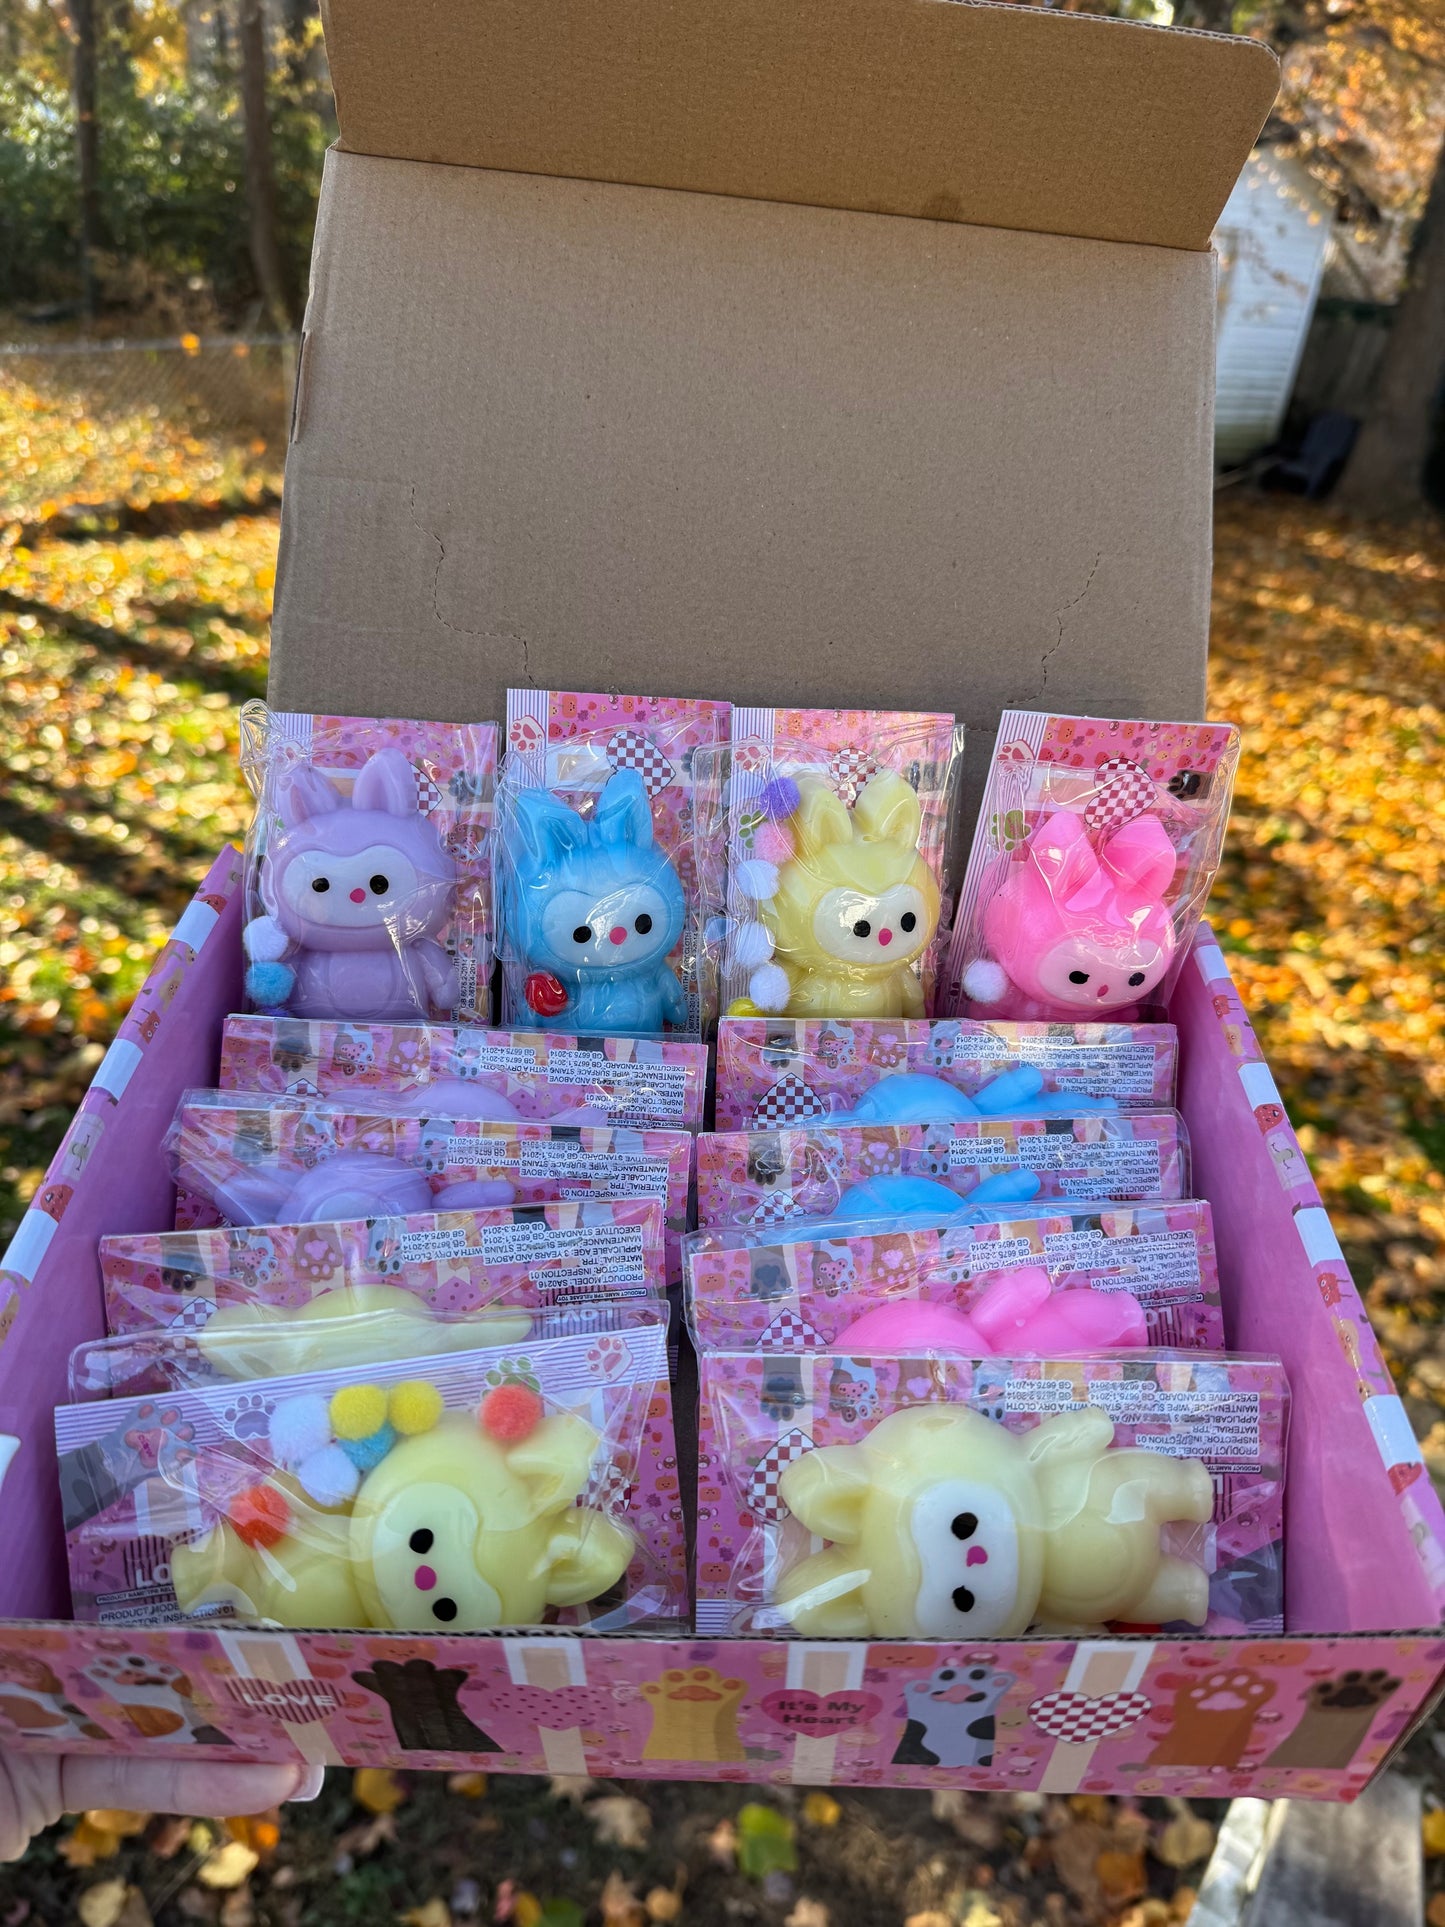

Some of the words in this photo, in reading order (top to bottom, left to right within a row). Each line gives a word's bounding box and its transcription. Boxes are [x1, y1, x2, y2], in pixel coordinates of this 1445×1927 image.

[476, 1156, 491, 1164] DRY
[499, 1157, 520, 1166] WITH
[451, 1229, 464, 1237] GB
[594, 1224, 640, 1236] EXECUTIVE
[401, 1230, 449, 1241] 6675.4-2014
[531, 1232, 544, 1241] GB
[1016, 1237, 1028, 1246] GB
[460, 1247, 483, 1256] WITH
[484, 1244, 514, 1254] STAINS
[570, 1248, 590, 1256] AGE:
[591, 1244, 642, 1255] APPLICABLE
[484, 1254, 514, 1263] ABOVE
[516, 1252, 532, 1261] AND
[534, 1250, 561, 1259] YEARS
[581, 1257, 598, 1265] TPR
[1077, 1260, 1093, 1269] AND
[1094, 1257, 1120, 1267] YEARS
[540, 1267, 592, 1278] INSPECTION
[592, 1262, 642, 1274] INSPECTOR:
[530, 1271, 539, 1279] 01
[601, 1272, 643, 1283] PRODUCT
[1101, 1273, 1150, 1286] INSPECTION
[538, 1278, 568, 1288] SA0216
[1091, 1278, 1100, 1287] 01
[1006, 1401, 1035, 1410] CLOTH
[1038, 1401, 1056, 1410] DRY
[1192, 1425, 1210, 1433] TPR
[1137, 1434, 1146, 1442] 01
[242, 1693, 336, 1706] LOVE
[778, 1701, 818, 1710] It's
[828, 1702, 864, 1713] My
[784, 1714, 857, 1724] Heart
